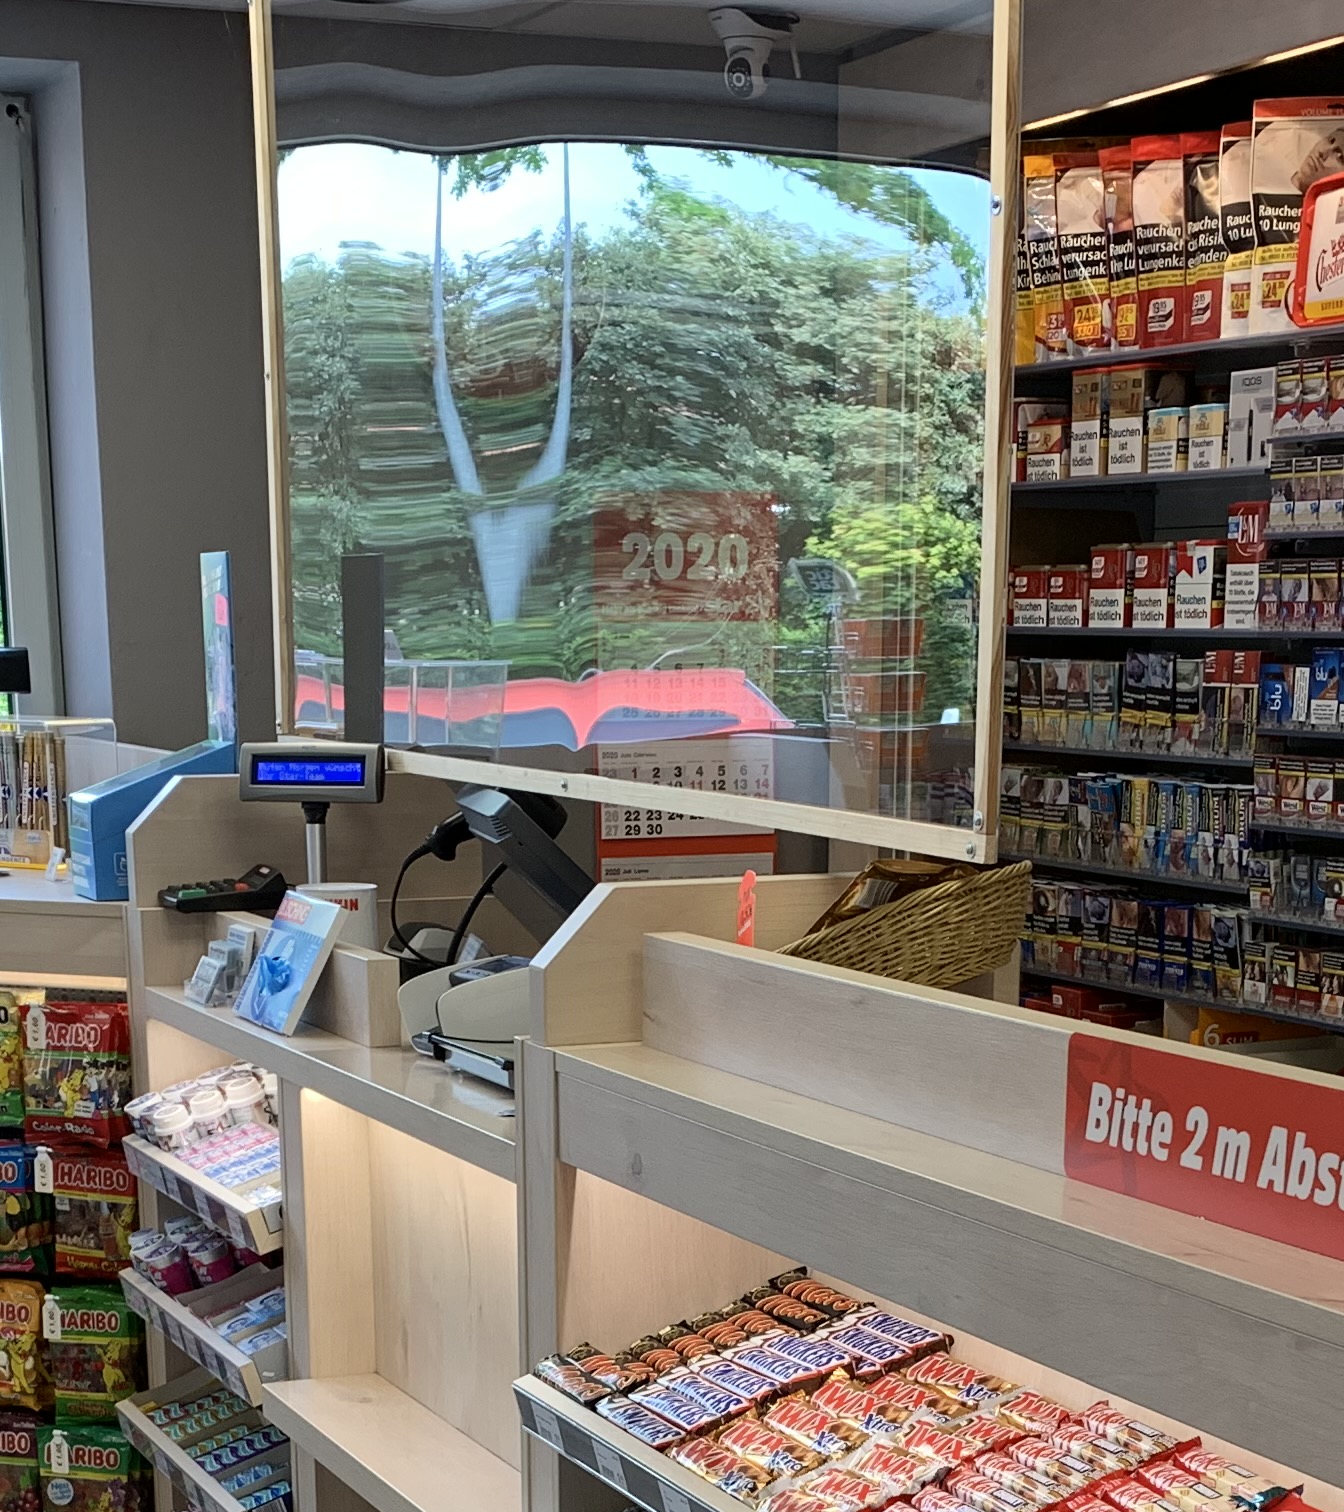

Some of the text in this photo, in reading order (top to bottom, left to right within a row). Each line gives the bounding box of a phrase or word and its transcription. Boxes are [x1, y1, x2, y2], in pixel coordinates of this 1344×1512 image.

[1109, 427, 1141, 441] Rauchen
[622, 533, 749, 581] 2020
[1316, 664, 1328, 682] blu
[631, 764, 769, 779] 1 2 3 4 5 6 7
[711, 778, 770, 791] 12 13 14
[624, 810, 663, 822] 22 23
[624, 824, 641, 836] 29
[646, 824, 663, 835] 30
[1085, 1082, 1174, 1162] Bitte
[1180, 1106, 1209, 1170] 2
[1212, 1124, 1251, 1183] m
[864, 1312, 943, 1344] SNICKERS
[907, 1353, 985, 1389] TWIX
[812, 1378, 883, 1419] TWIX
